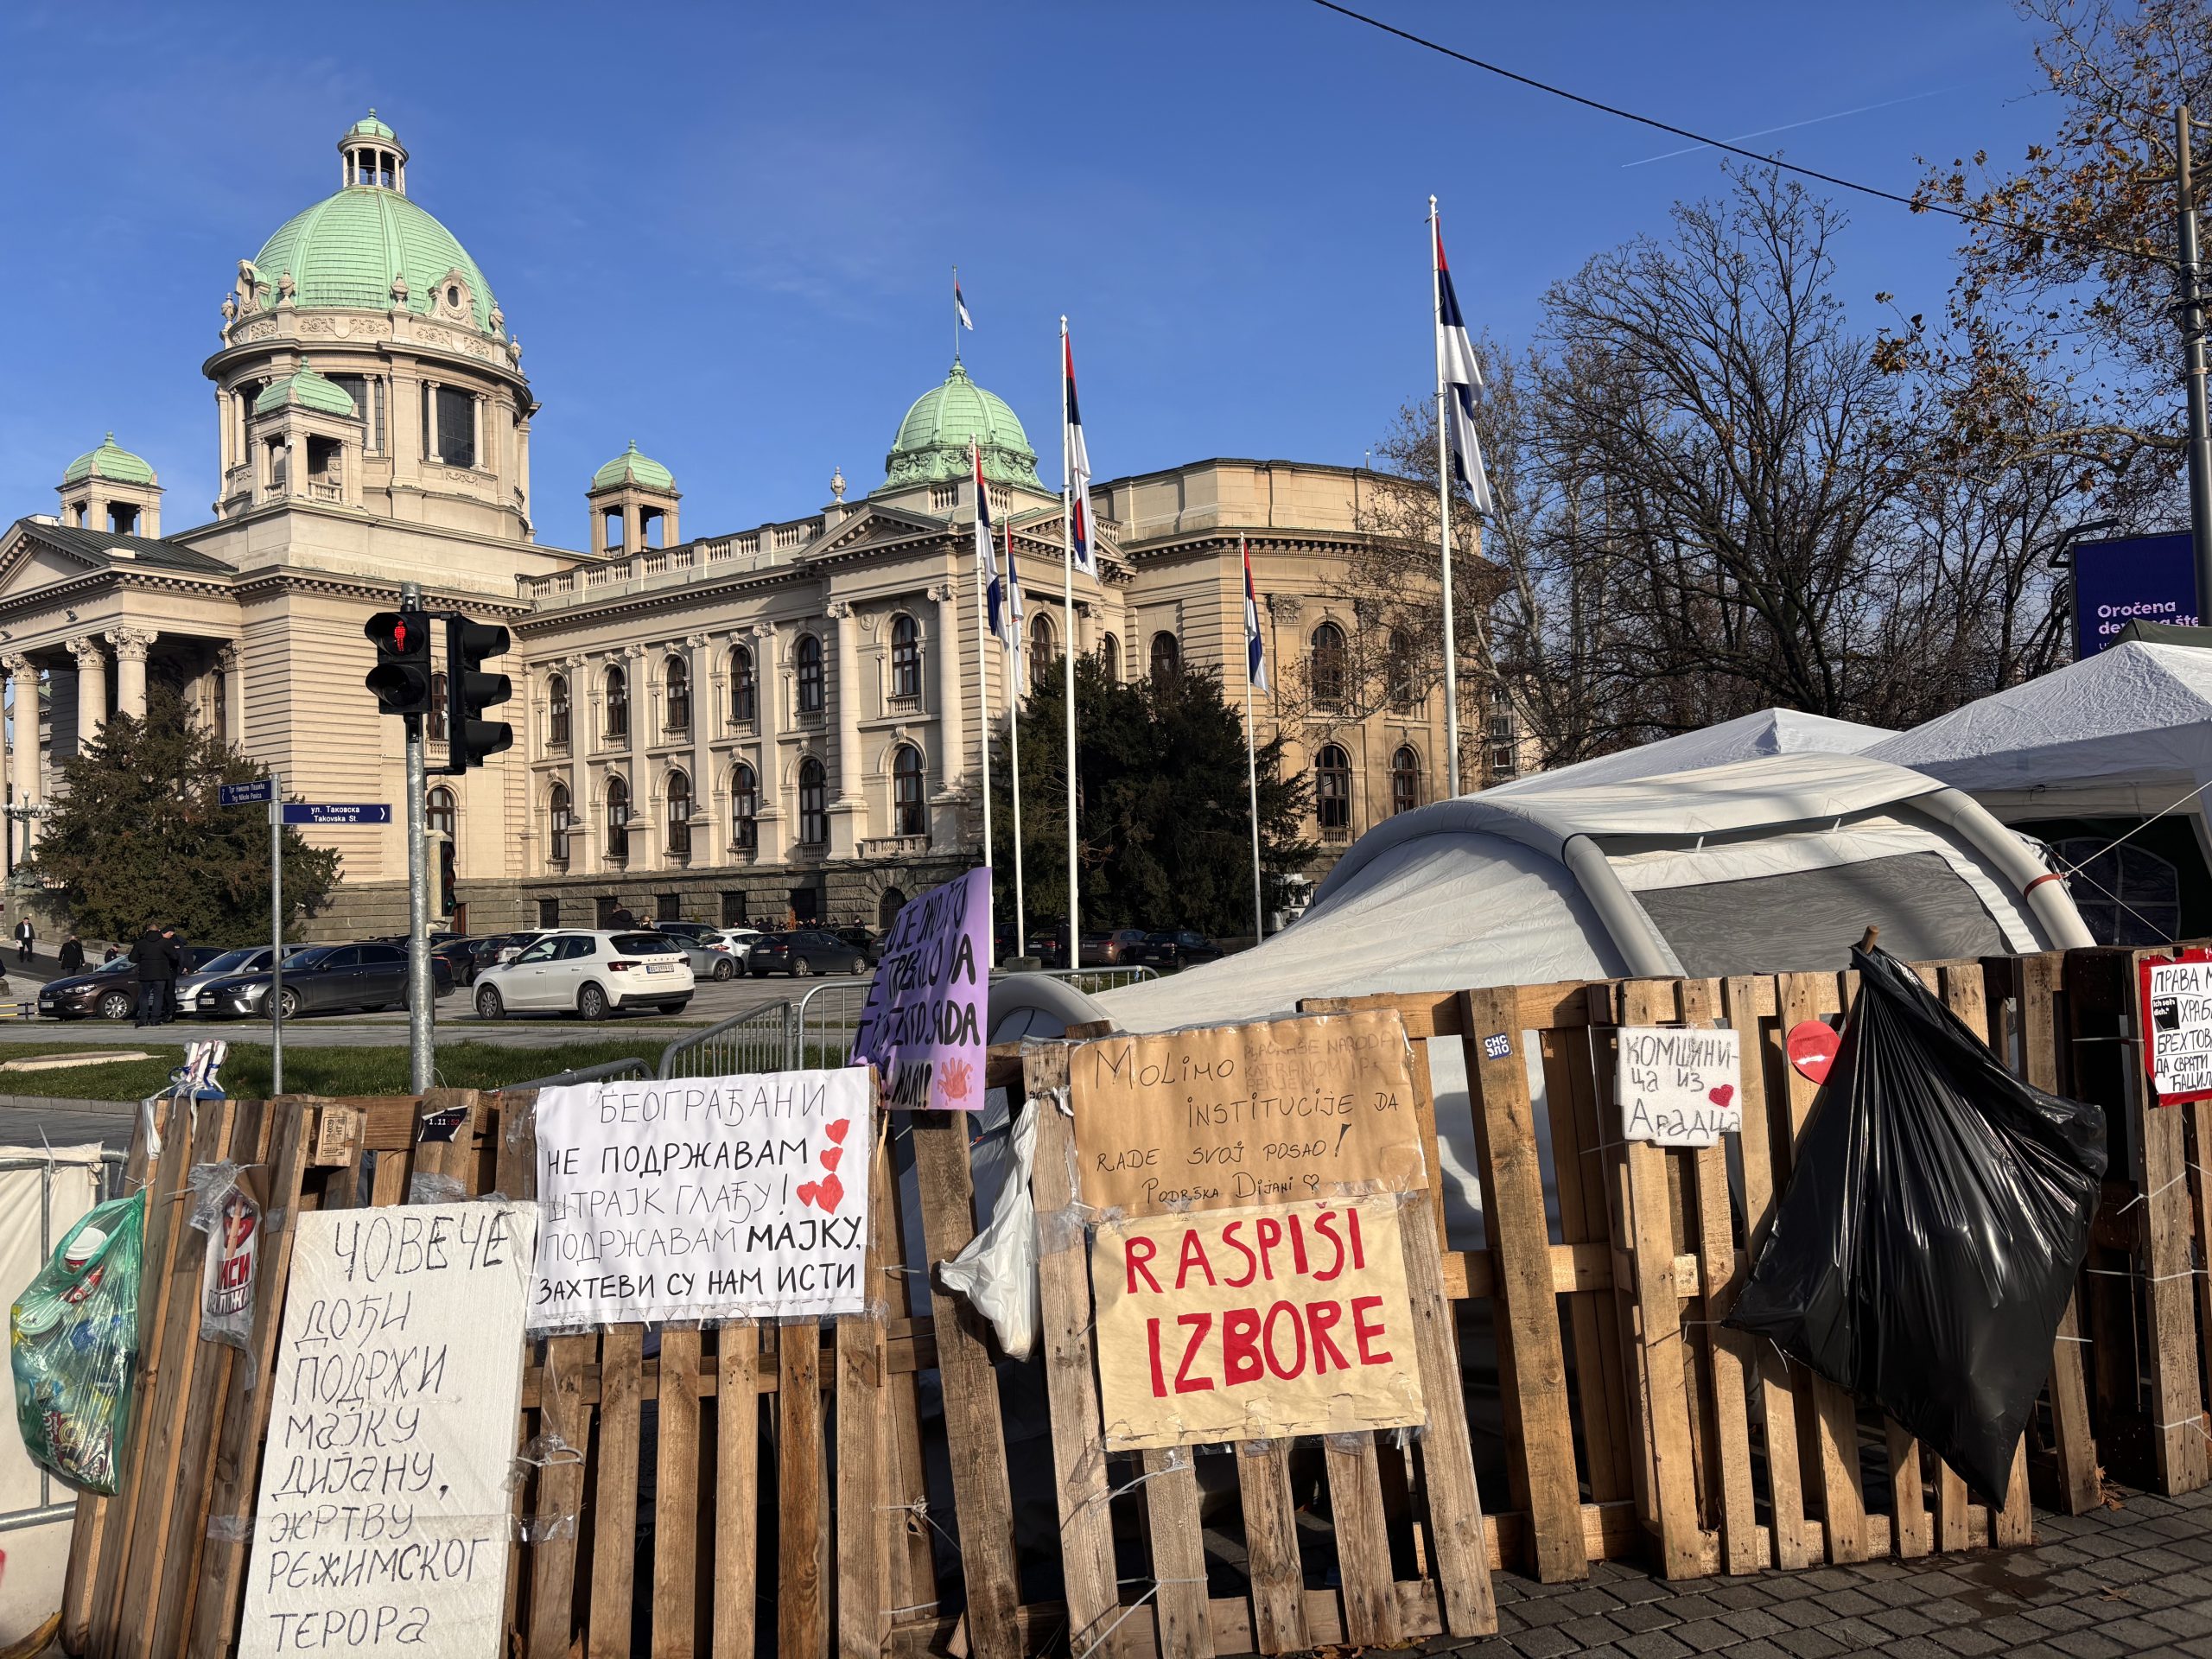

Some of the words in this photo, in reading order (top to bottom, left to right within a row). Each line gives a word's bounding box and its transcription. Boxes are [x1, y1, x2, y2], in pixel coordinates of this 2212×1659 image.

[2097, 601, 2176, 618] Oročena
[2154, 967, 2199, 993] ПРАВА
[2152, 999, 2162, 1007] Ich
[2180, 997, 2212, 1023] ХРАБ
[1484, 1034, 1508, 1049] СНС
[2155, 1057, 2169, 1078] ДА
[2174, 1053, 2208, 1072] СВРАТИ
[2169, 1071, 2212, 1092] ЋАЦИЛ
[601, 1084, 825, 1127] БЕОГРАЂАНИ
[1374, 1091, 1400, 1112] DA
[548, 1147, 580, 1178] НЕ
[601, 1137, 808, 1179] ПОДРЖАВАМ
[1096, 1147, 1160, 1172] RADE
[1187, 1141, 1245, 1166] SVOJ
[548, 1186, 665, 1223] ШТРАЈК
[334, 1210, 517, 1282] ЧОВЕЧЕ
[543, 1226, 737, 1267] ПОДРЖАВАМ
[746, 1215, 862, 1253] МАЈКУ,
[1125, 1201, 1365, 1294] RASPIŠI
[536, 1274, 655, 1305] ЗАХТЕВИ
[666, 1272, 696, 1296] СУ
[709, 1267, 764, 1296] НАМ
[778, 1262, 855, 1294] ИСТИ
[294, 1290, 412, 1352] ДОЂИ
[1147, 1295, 1393, 1398] IZBORE
[292, 1344, 448, 1408] ПОДРЖИ
[269, 1503, 415, 1543] ЖРТВУ
[267, 1537, 490, 1595] РЕЖИМСКОГ
